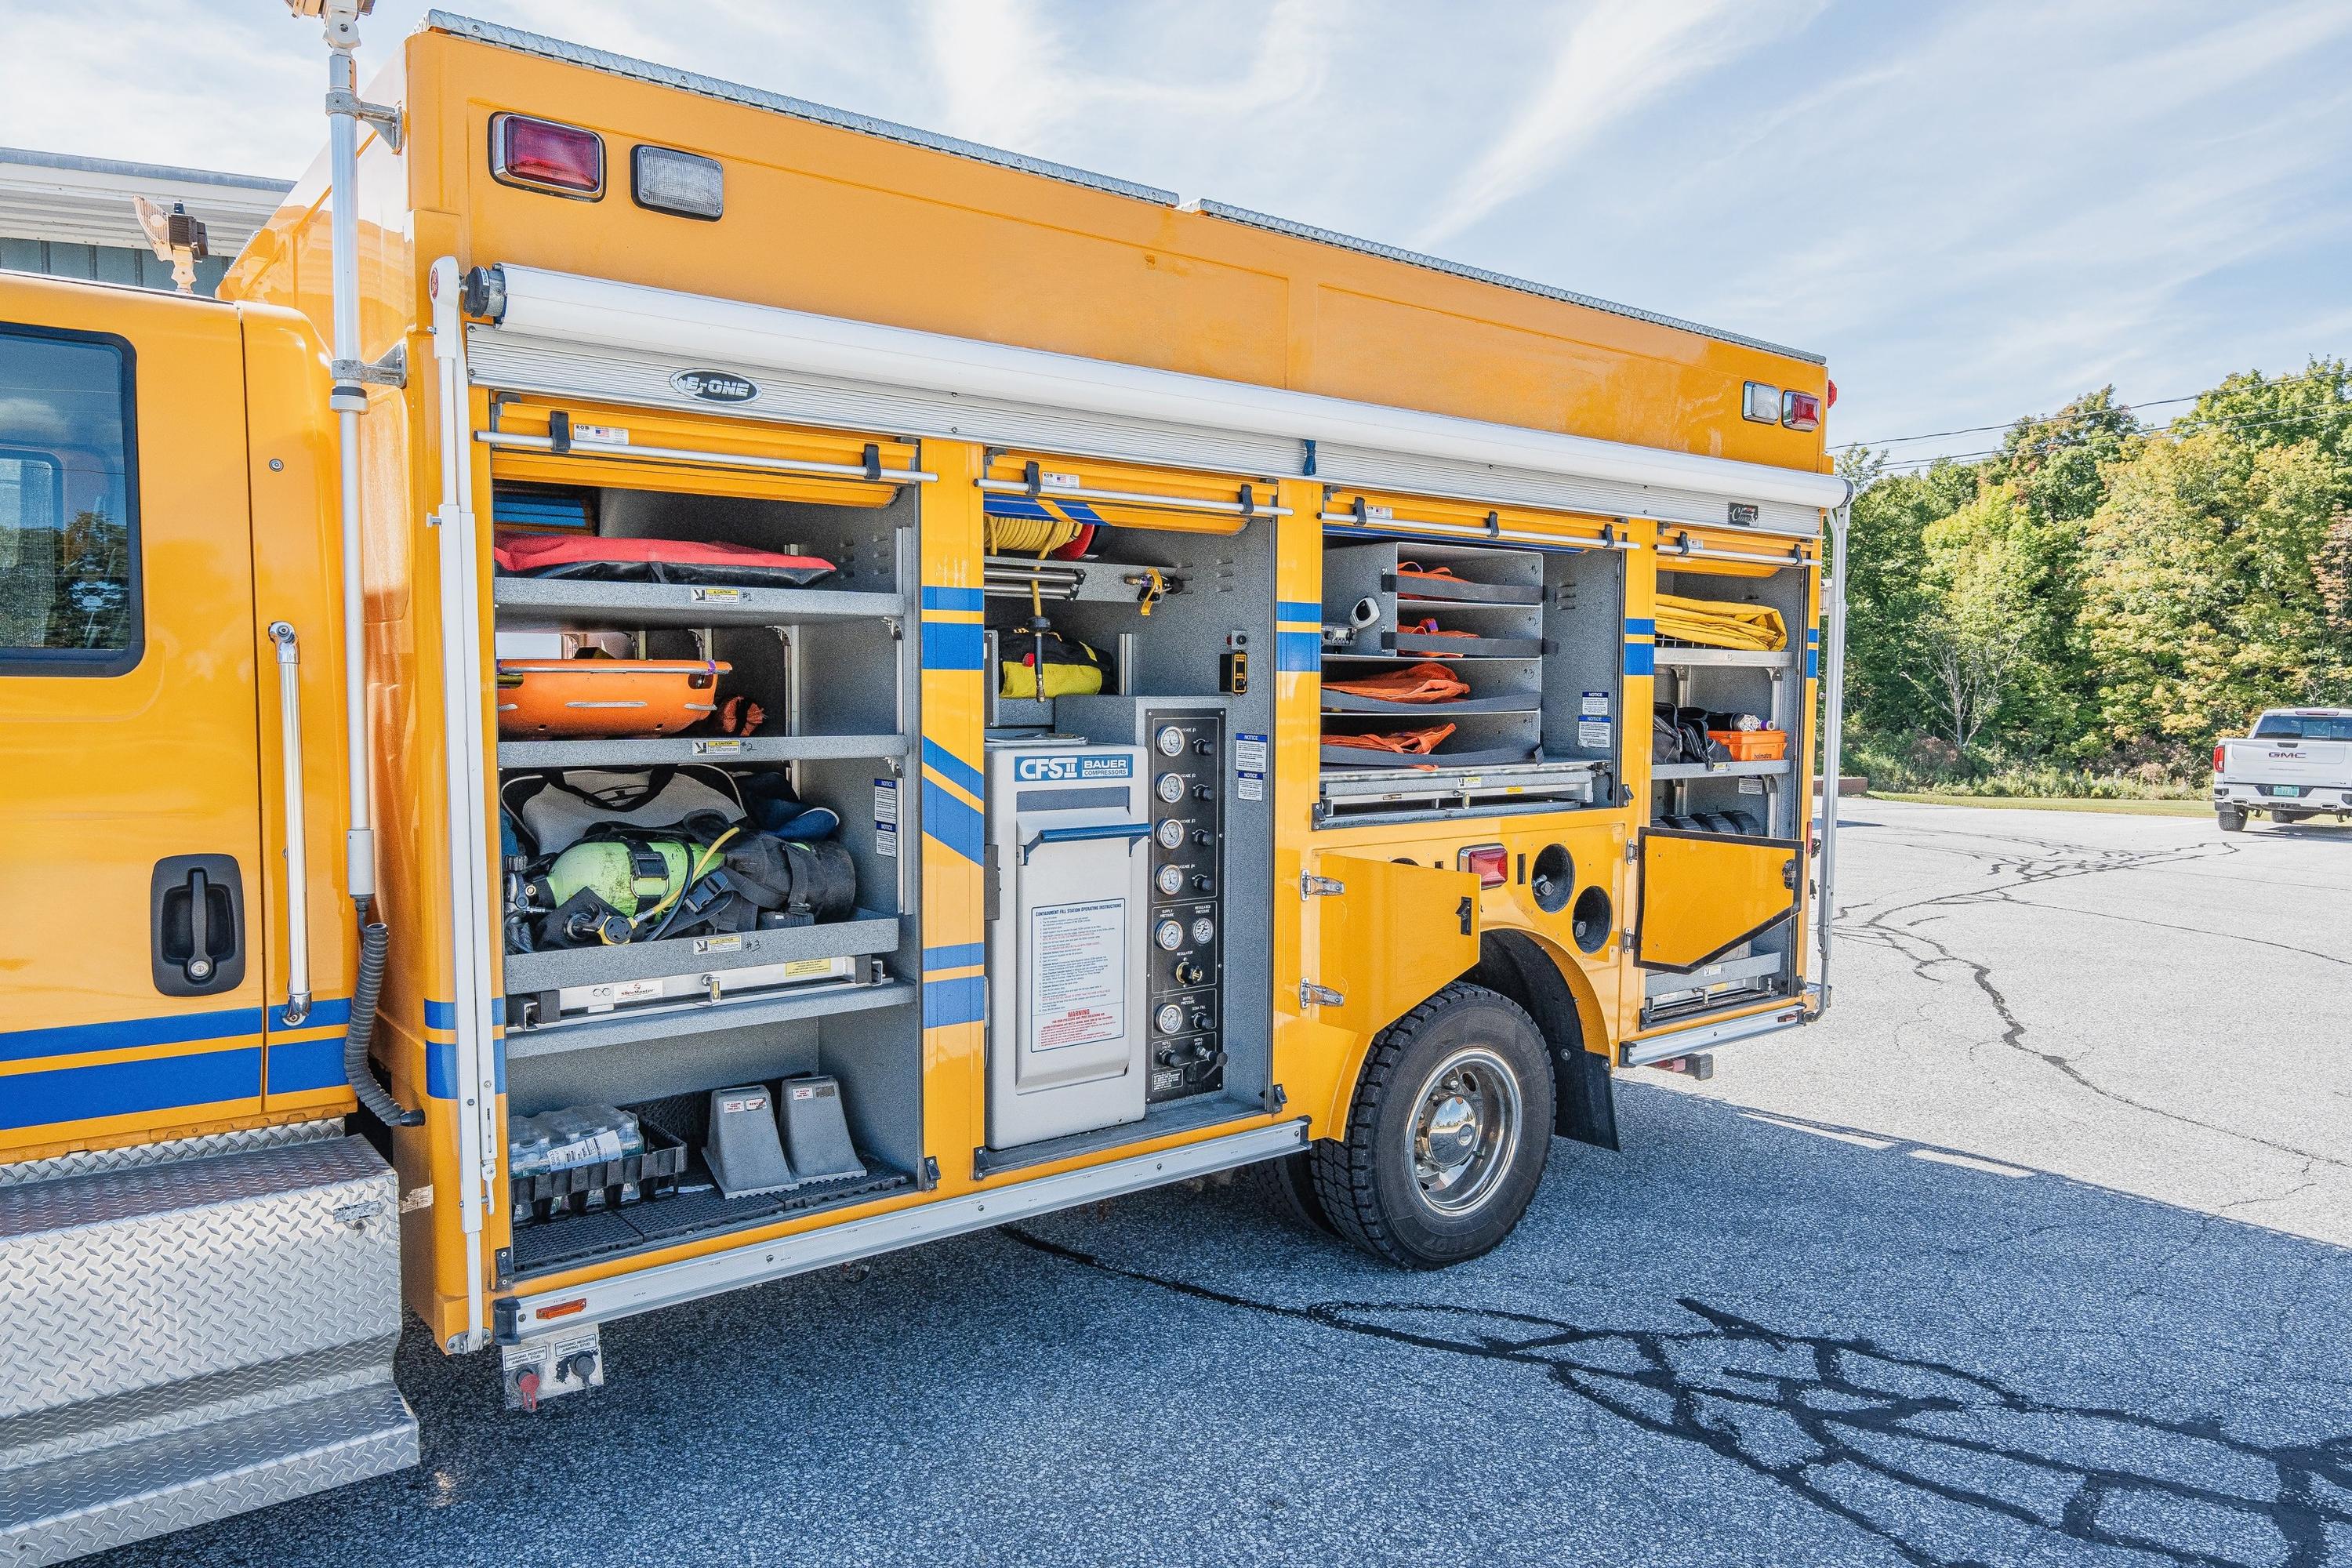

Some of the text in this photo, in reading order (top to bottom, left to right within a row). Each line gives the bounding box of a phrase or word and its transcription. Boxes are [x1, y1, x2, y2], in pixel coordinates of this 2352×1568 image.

[686, 376, 750, 397] E-ONE
[742, 591, 753, 601] #1
[1084, 760, 1127, 768] BAUER
[745, 940, 761, 952] #3
[1067, 1008, 1089, 1017] WARNING
[506, 1353, 527, 1362] CHARGING
